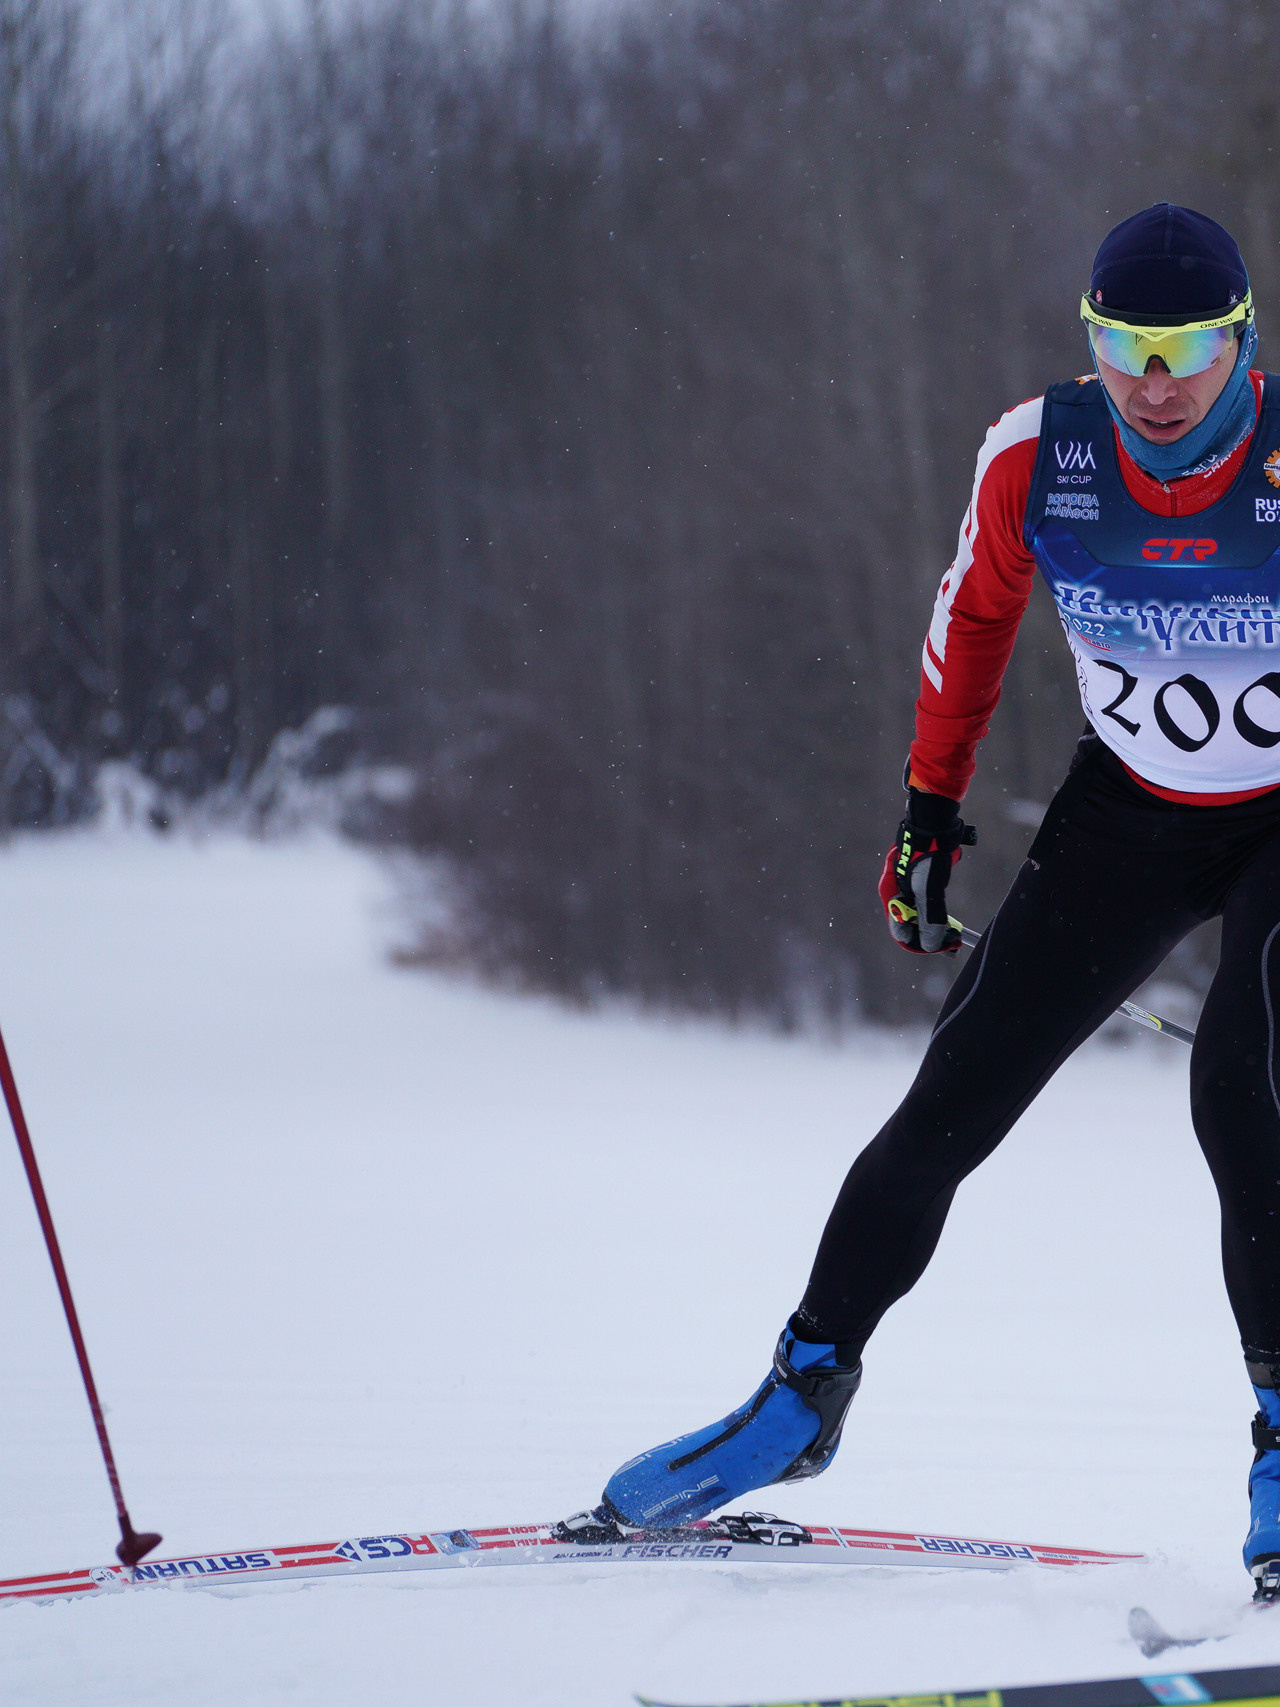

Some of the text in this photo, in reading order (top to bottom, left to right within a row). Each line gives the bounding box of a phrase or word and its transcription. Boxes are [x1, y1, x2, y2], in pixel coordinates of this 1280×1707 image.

[1056, 475, 1092, 484] SKI CUP
[1046, 493, 1100, 507] ВОЛОГДА
[1044, 504, 1100, 520] МАРАФОН
[1210, 593, 1270, 607] марафон
[896, 830, 912, 876] LEKI
[642, 1474, 720, 1520] SPINE
[621, 1545, 733, 1559] FISCHER
[918, 1537, 1034, 1560] FISCHER
[134, 1551, 273, 1581] SATURN
